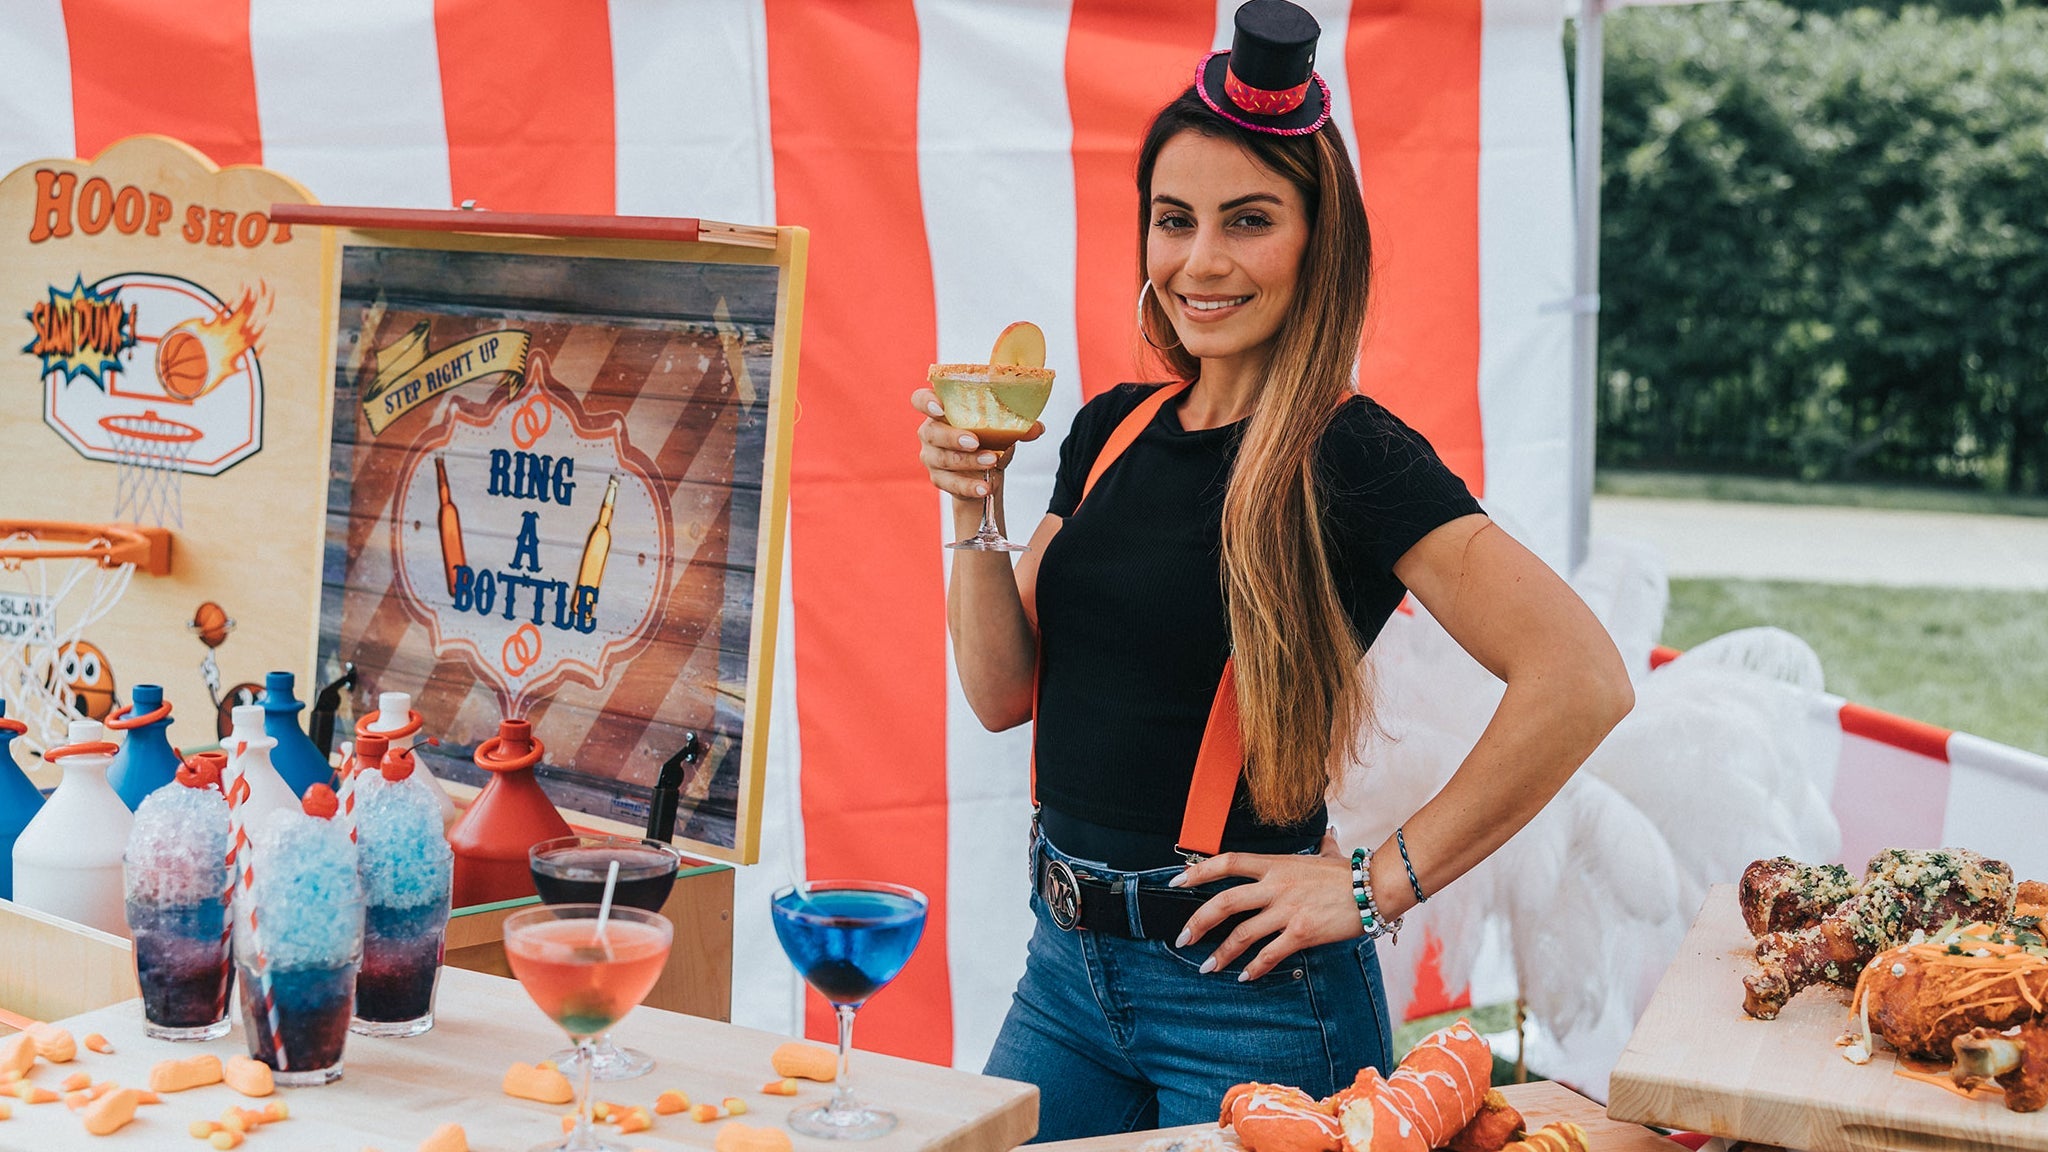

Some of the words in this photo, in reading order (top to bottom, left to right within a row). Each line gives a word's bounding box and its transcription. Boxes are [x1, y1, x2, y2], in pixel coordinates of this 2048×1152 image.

[29, 168, 173, 244] HOOP
[33, 301, 73, 358] SLAM
[384, 379, 422, 415] STEP
[425, 349, 474, 393] RIGHT
[479, 337, 499, 363] UP
[487, 449, 576, 506] RING
[508, 511, 543, 573] A
[452, 564, 600, 634] BOTTLE
